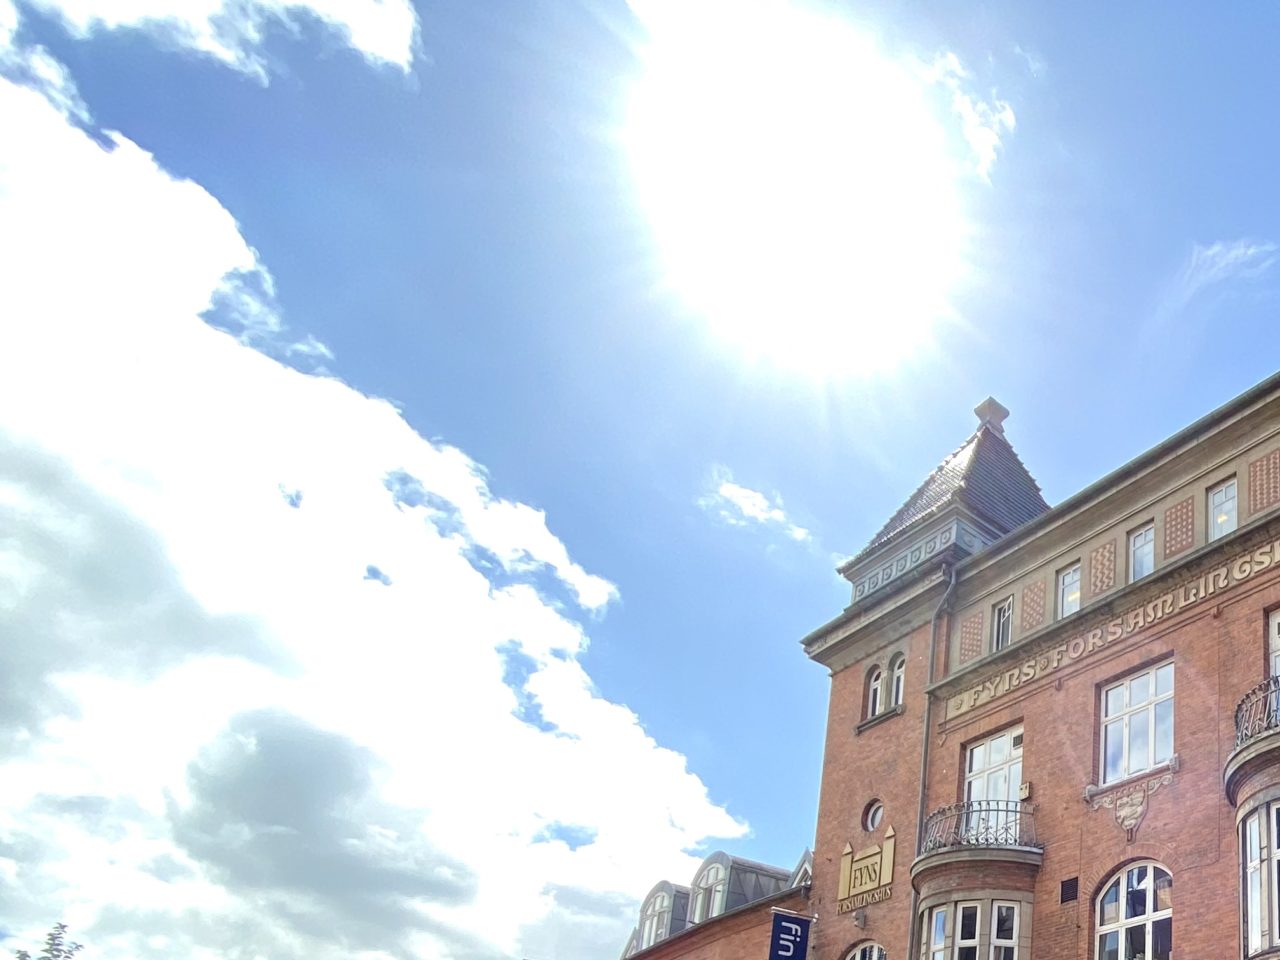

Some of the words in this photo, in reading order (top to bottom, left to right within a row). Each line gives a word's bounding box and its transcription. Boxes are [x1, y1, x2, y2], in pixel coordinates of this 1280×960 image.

[967, 658, 1037, 708] FYNS
[852, 862, 878, 889] FYNS
[836, 886, 892, 915] FORSAMLINGSHUS
[778, 921, 801, 956] fin
